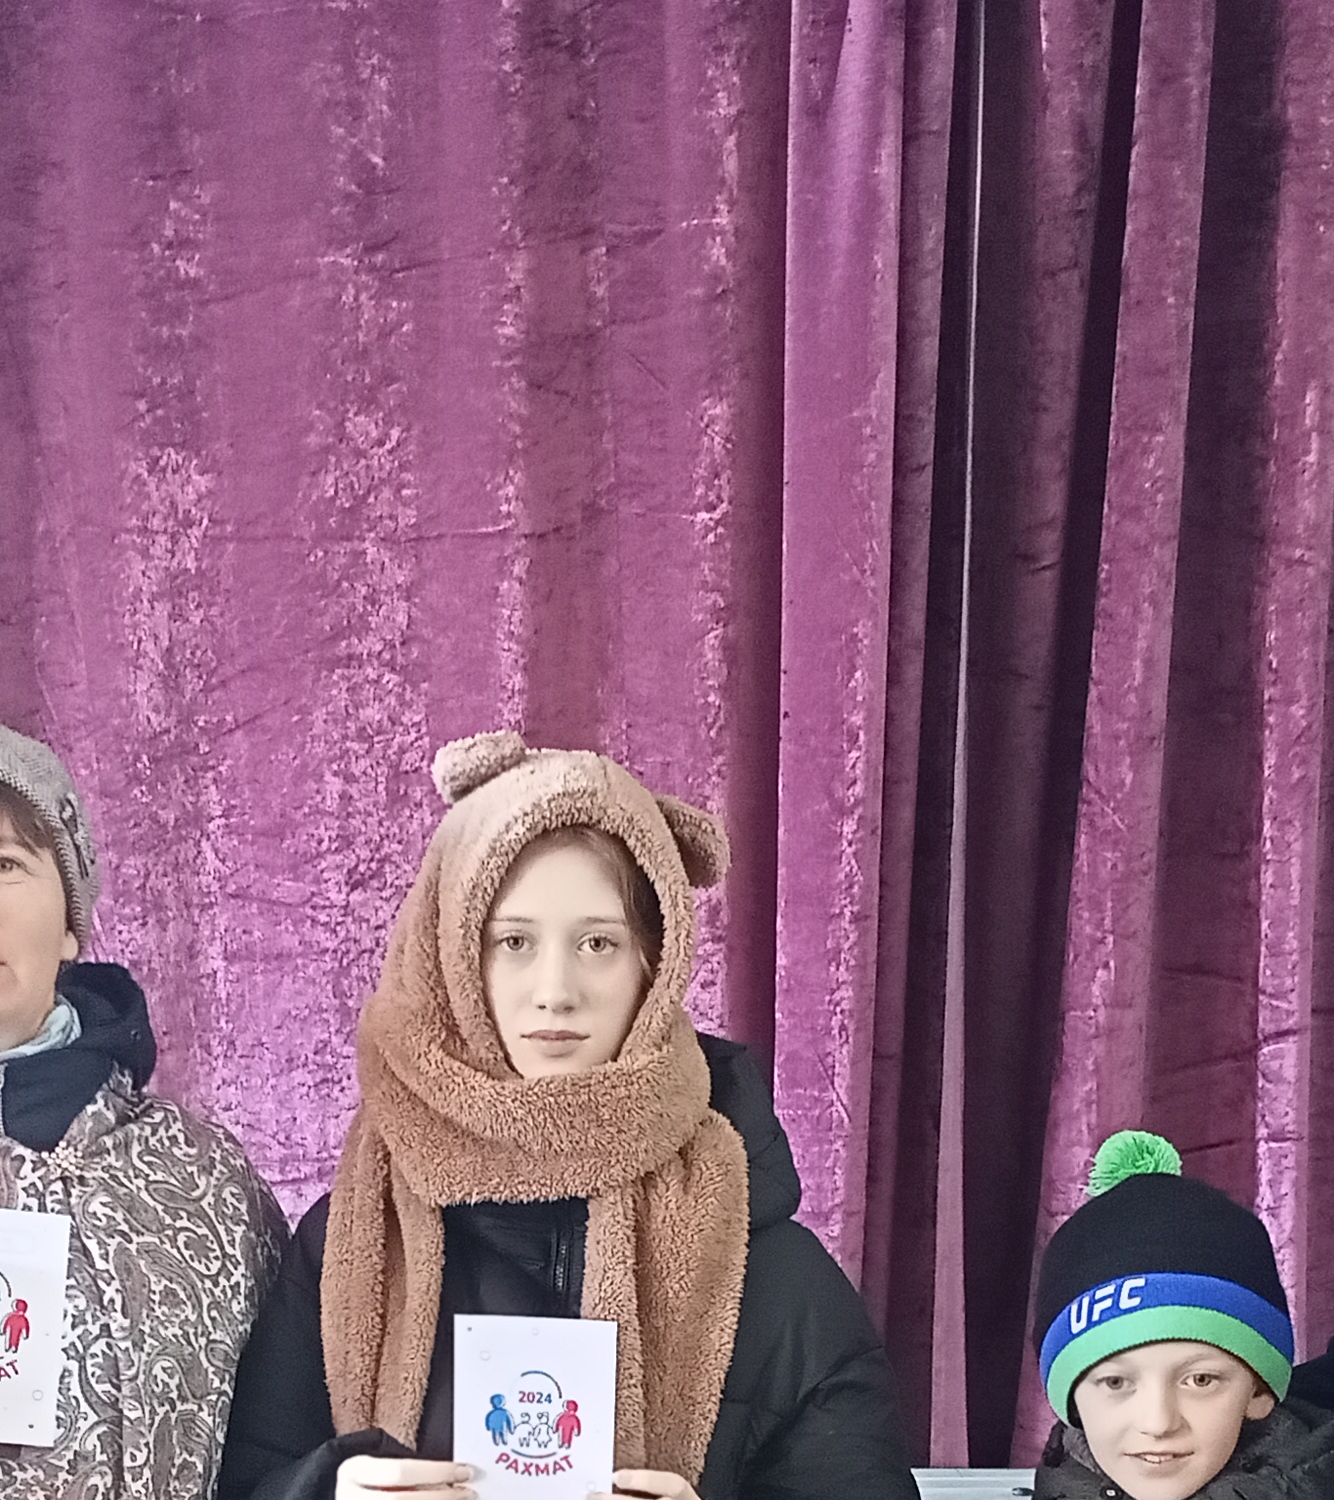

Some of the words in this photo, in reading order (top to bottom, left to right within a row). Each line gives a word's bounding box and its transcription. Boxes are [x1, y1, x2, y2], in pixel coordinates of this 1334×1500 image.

[1069, 1277, 1146, 1335] UFC
[518, 1390, 553, 1405] 2024
[494, 1451, 575, 1477] РАХМАТ
